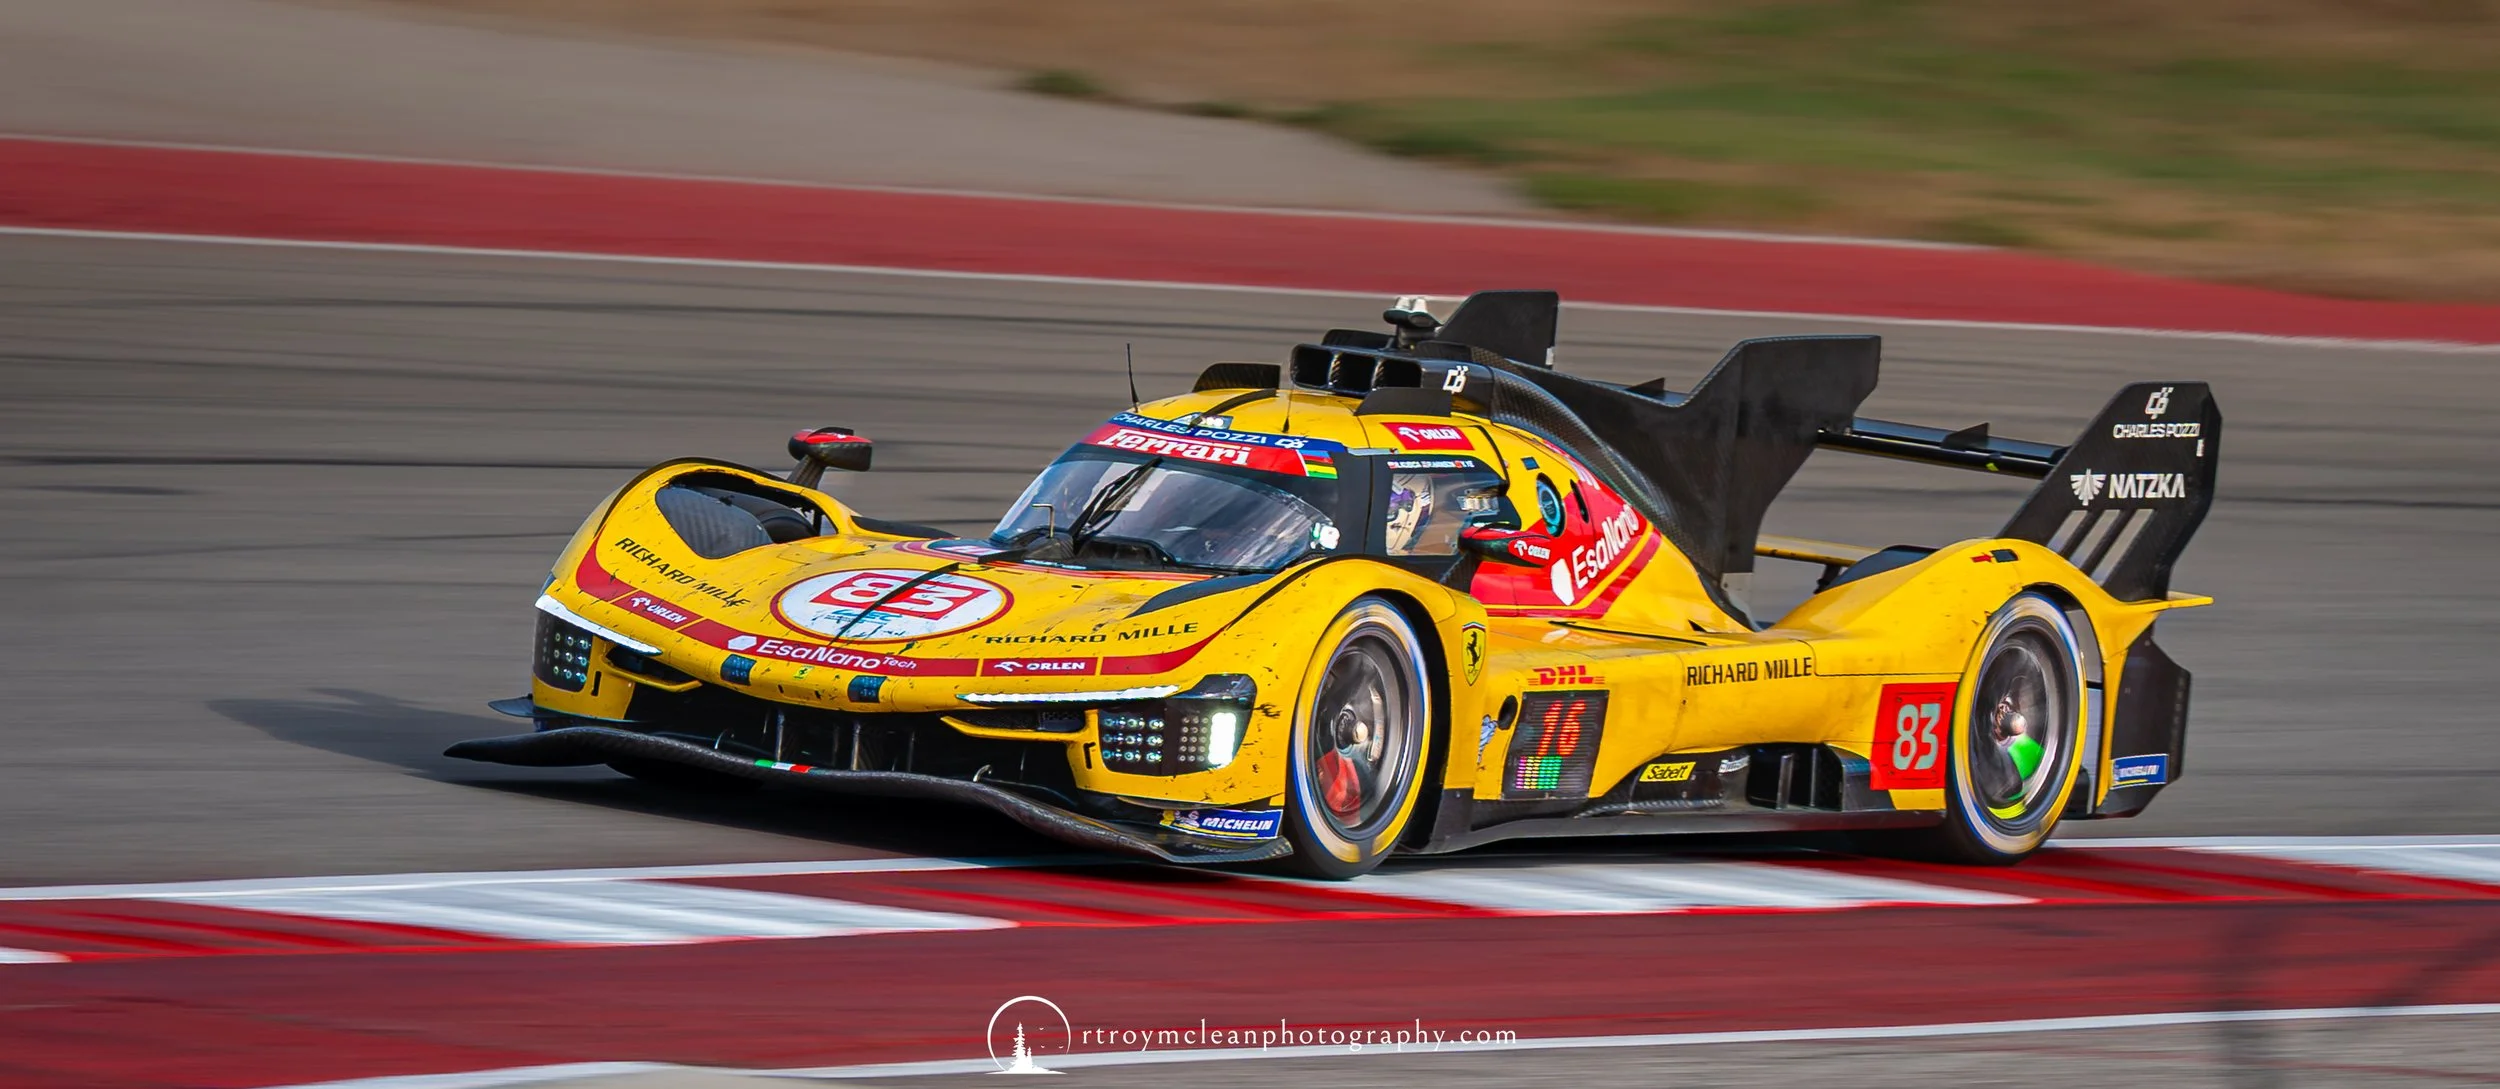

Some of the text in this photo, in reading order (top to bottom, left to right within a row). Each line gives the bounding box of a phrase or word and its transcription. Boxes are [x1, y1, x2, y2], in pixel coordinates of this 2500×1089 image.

[1113, 413, 1192, 435] CHARLES
[1195, 428, 1266, 444] POZZI
[1418, 428, 1462, 440] ORLEN
[2113, 423, 2200, 438] CHARLES POZZI
[1097, 428, 1252, 465] Ferrari
[2108, 474, 2186, 499] NATZKA
[1572, 503, 1640, 589] EsaNano
[615, 537, 750, 608] RICHARD MILLE
[830, 577, 974, 613] 83
[647, 604, 688, 624] ORLEN
[985, 622, 1198, 644] RICHARD MILLE
[756, 639, 917, 669] EsaNano Tech
[1026, 661, 1085, 670] ORLEN
[1533, 665, 1594, 686] DHL
[1687, 657, 1813, 687] RICHARD MILLE
[1536, 699, 1588, 757] 16
[1892, 702, 1942, 771] 83
[1201, 817, 1274, 831] MICHELIN
